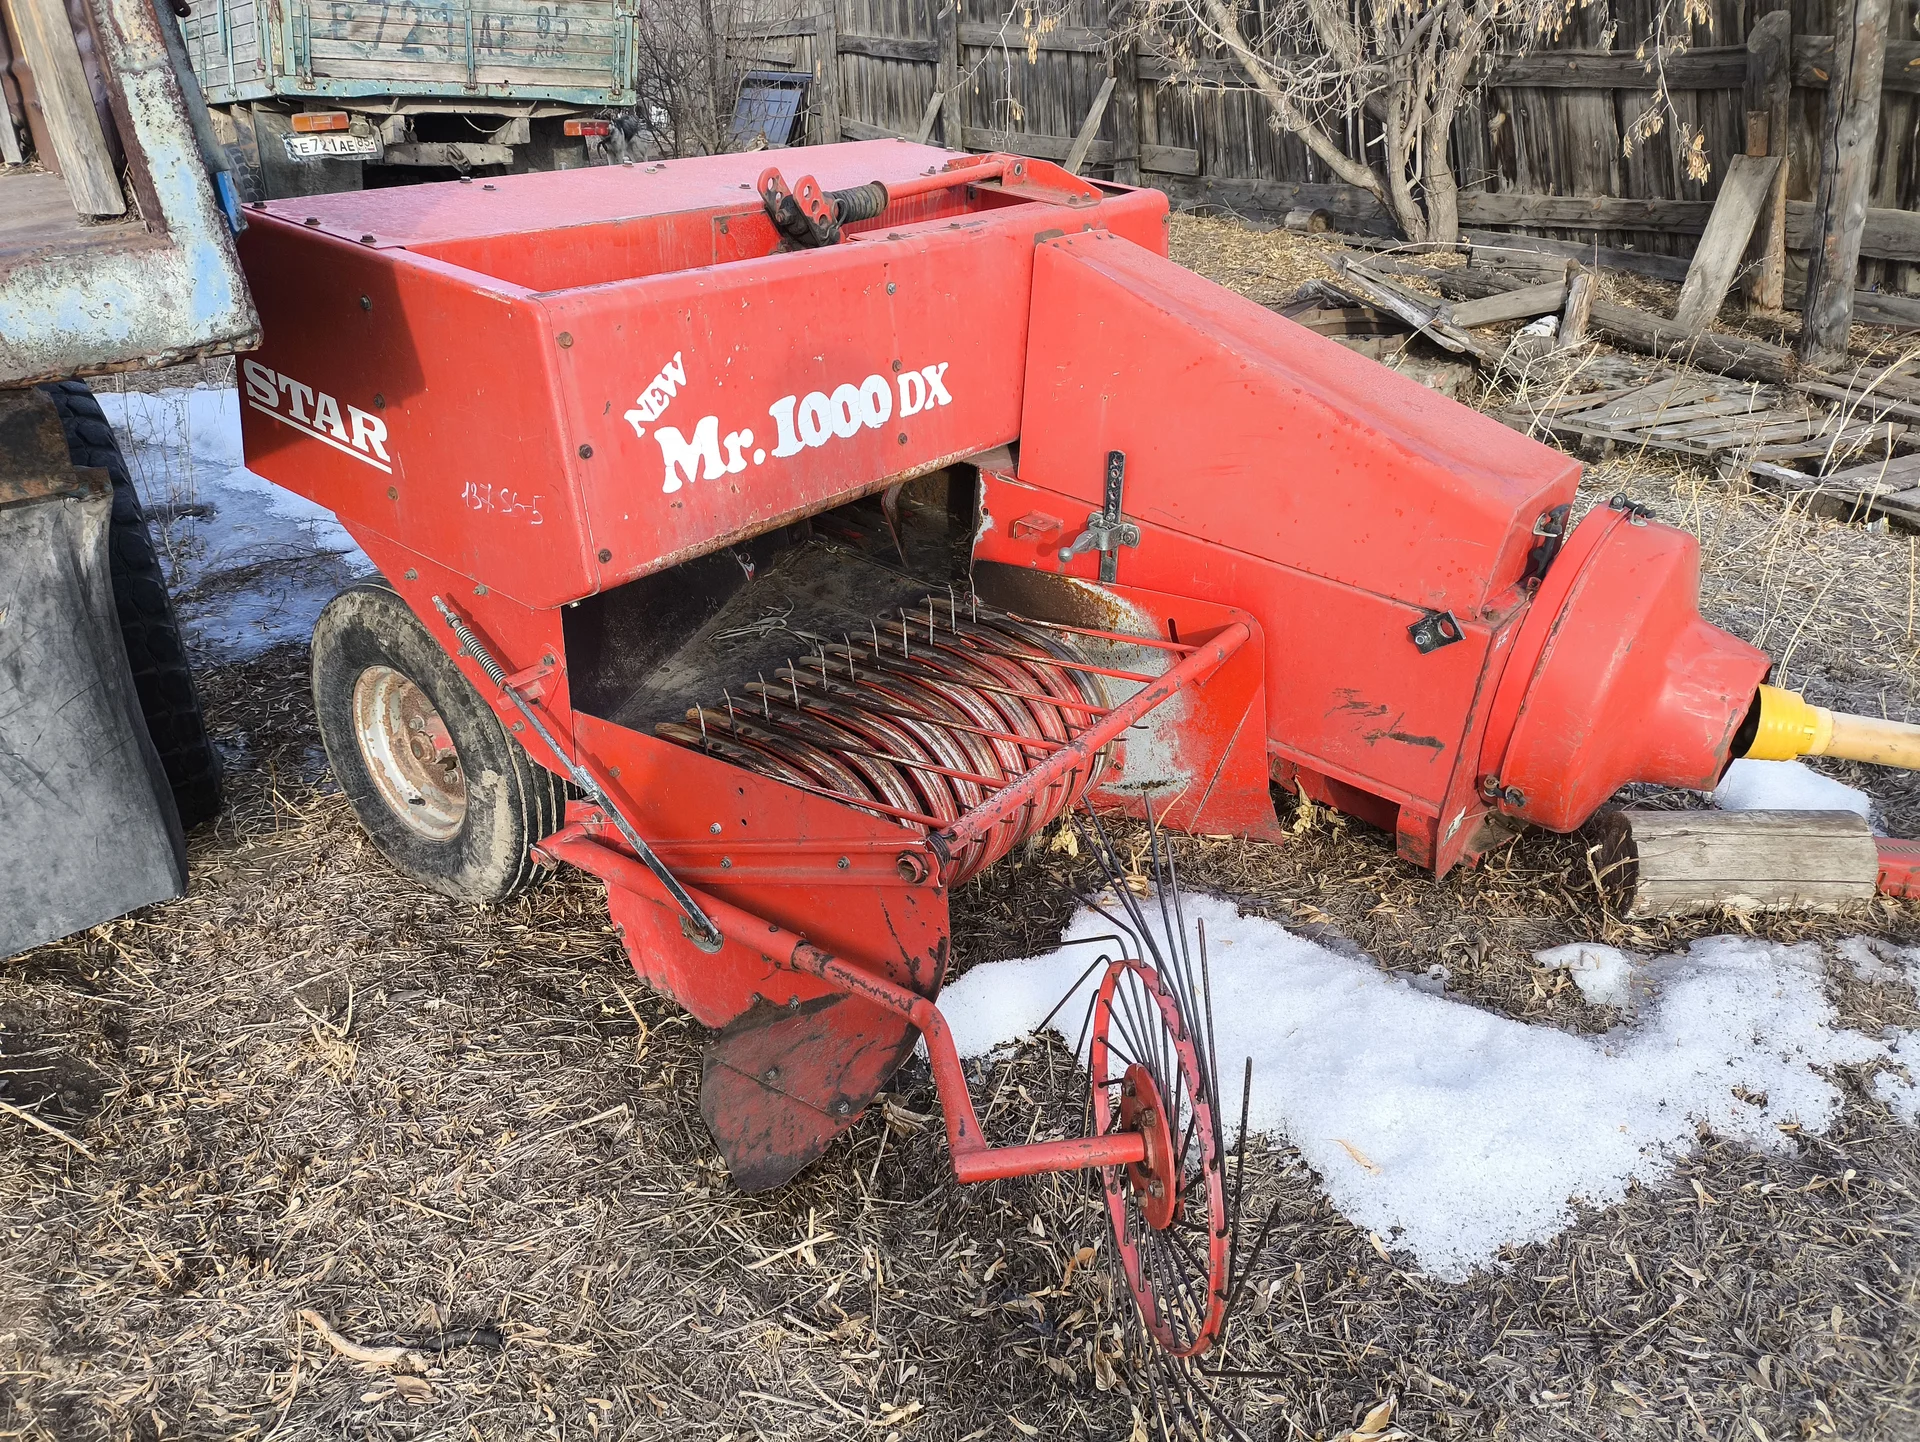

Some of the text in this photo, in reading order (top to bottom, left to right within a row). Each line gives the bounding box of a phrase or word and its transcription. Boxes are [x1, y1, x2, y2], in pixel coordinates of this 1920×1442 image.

[243, 358, 391, 463] STAR
[624, 350, 687, 438] NEW
[653, 361, 953, 494] Mr. 1000 DX
